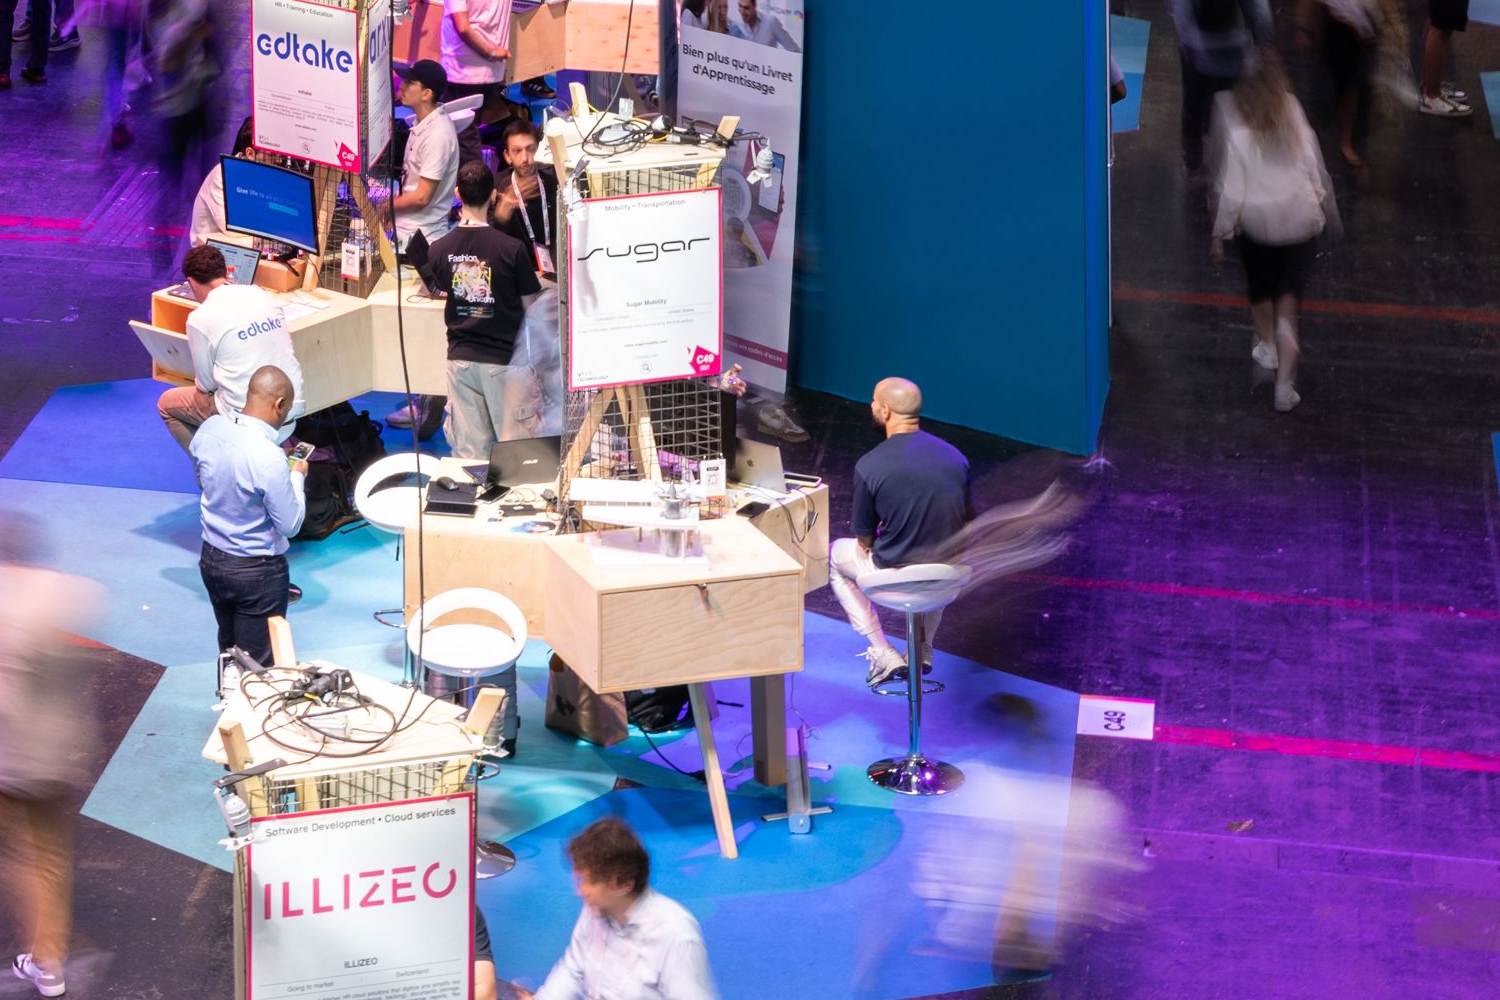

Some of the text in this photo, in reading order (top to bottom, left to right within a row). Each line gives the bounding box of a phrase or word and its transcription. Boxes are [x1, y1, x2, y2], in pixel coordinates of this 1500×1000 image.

[286, 3, 306, 14] Training
[309, 9, 334, 19] Education
[256, 32, 353, 73] edtake
[682, 43, 794, 82] Bien plus qu'un Livret
[692, 63, 776, 96] d'Apprentissage
[341, 151, 355, 162] C49
[236, 186, 249, 195] Give
[605, 199, 686, 212] Mobility Transportation
[577, 237, 711, 263] sugar
[448, 254, 477, 263] Fashion
[626, 298, 667, 309] Sugar Mobility
[237, 317, 282, 341] edtake
[696, 353, 714, 364] C49
[1103, 710, 1126, 732] C49
[265, 807, 456, 838] Software Development Cloud services
[263, 862, 457, 920] ILLIZEO
[344, 957, 379, 969] ILLIZEO
[286, 984, 306, 993] Going
[313, 980, 335, 989] market
